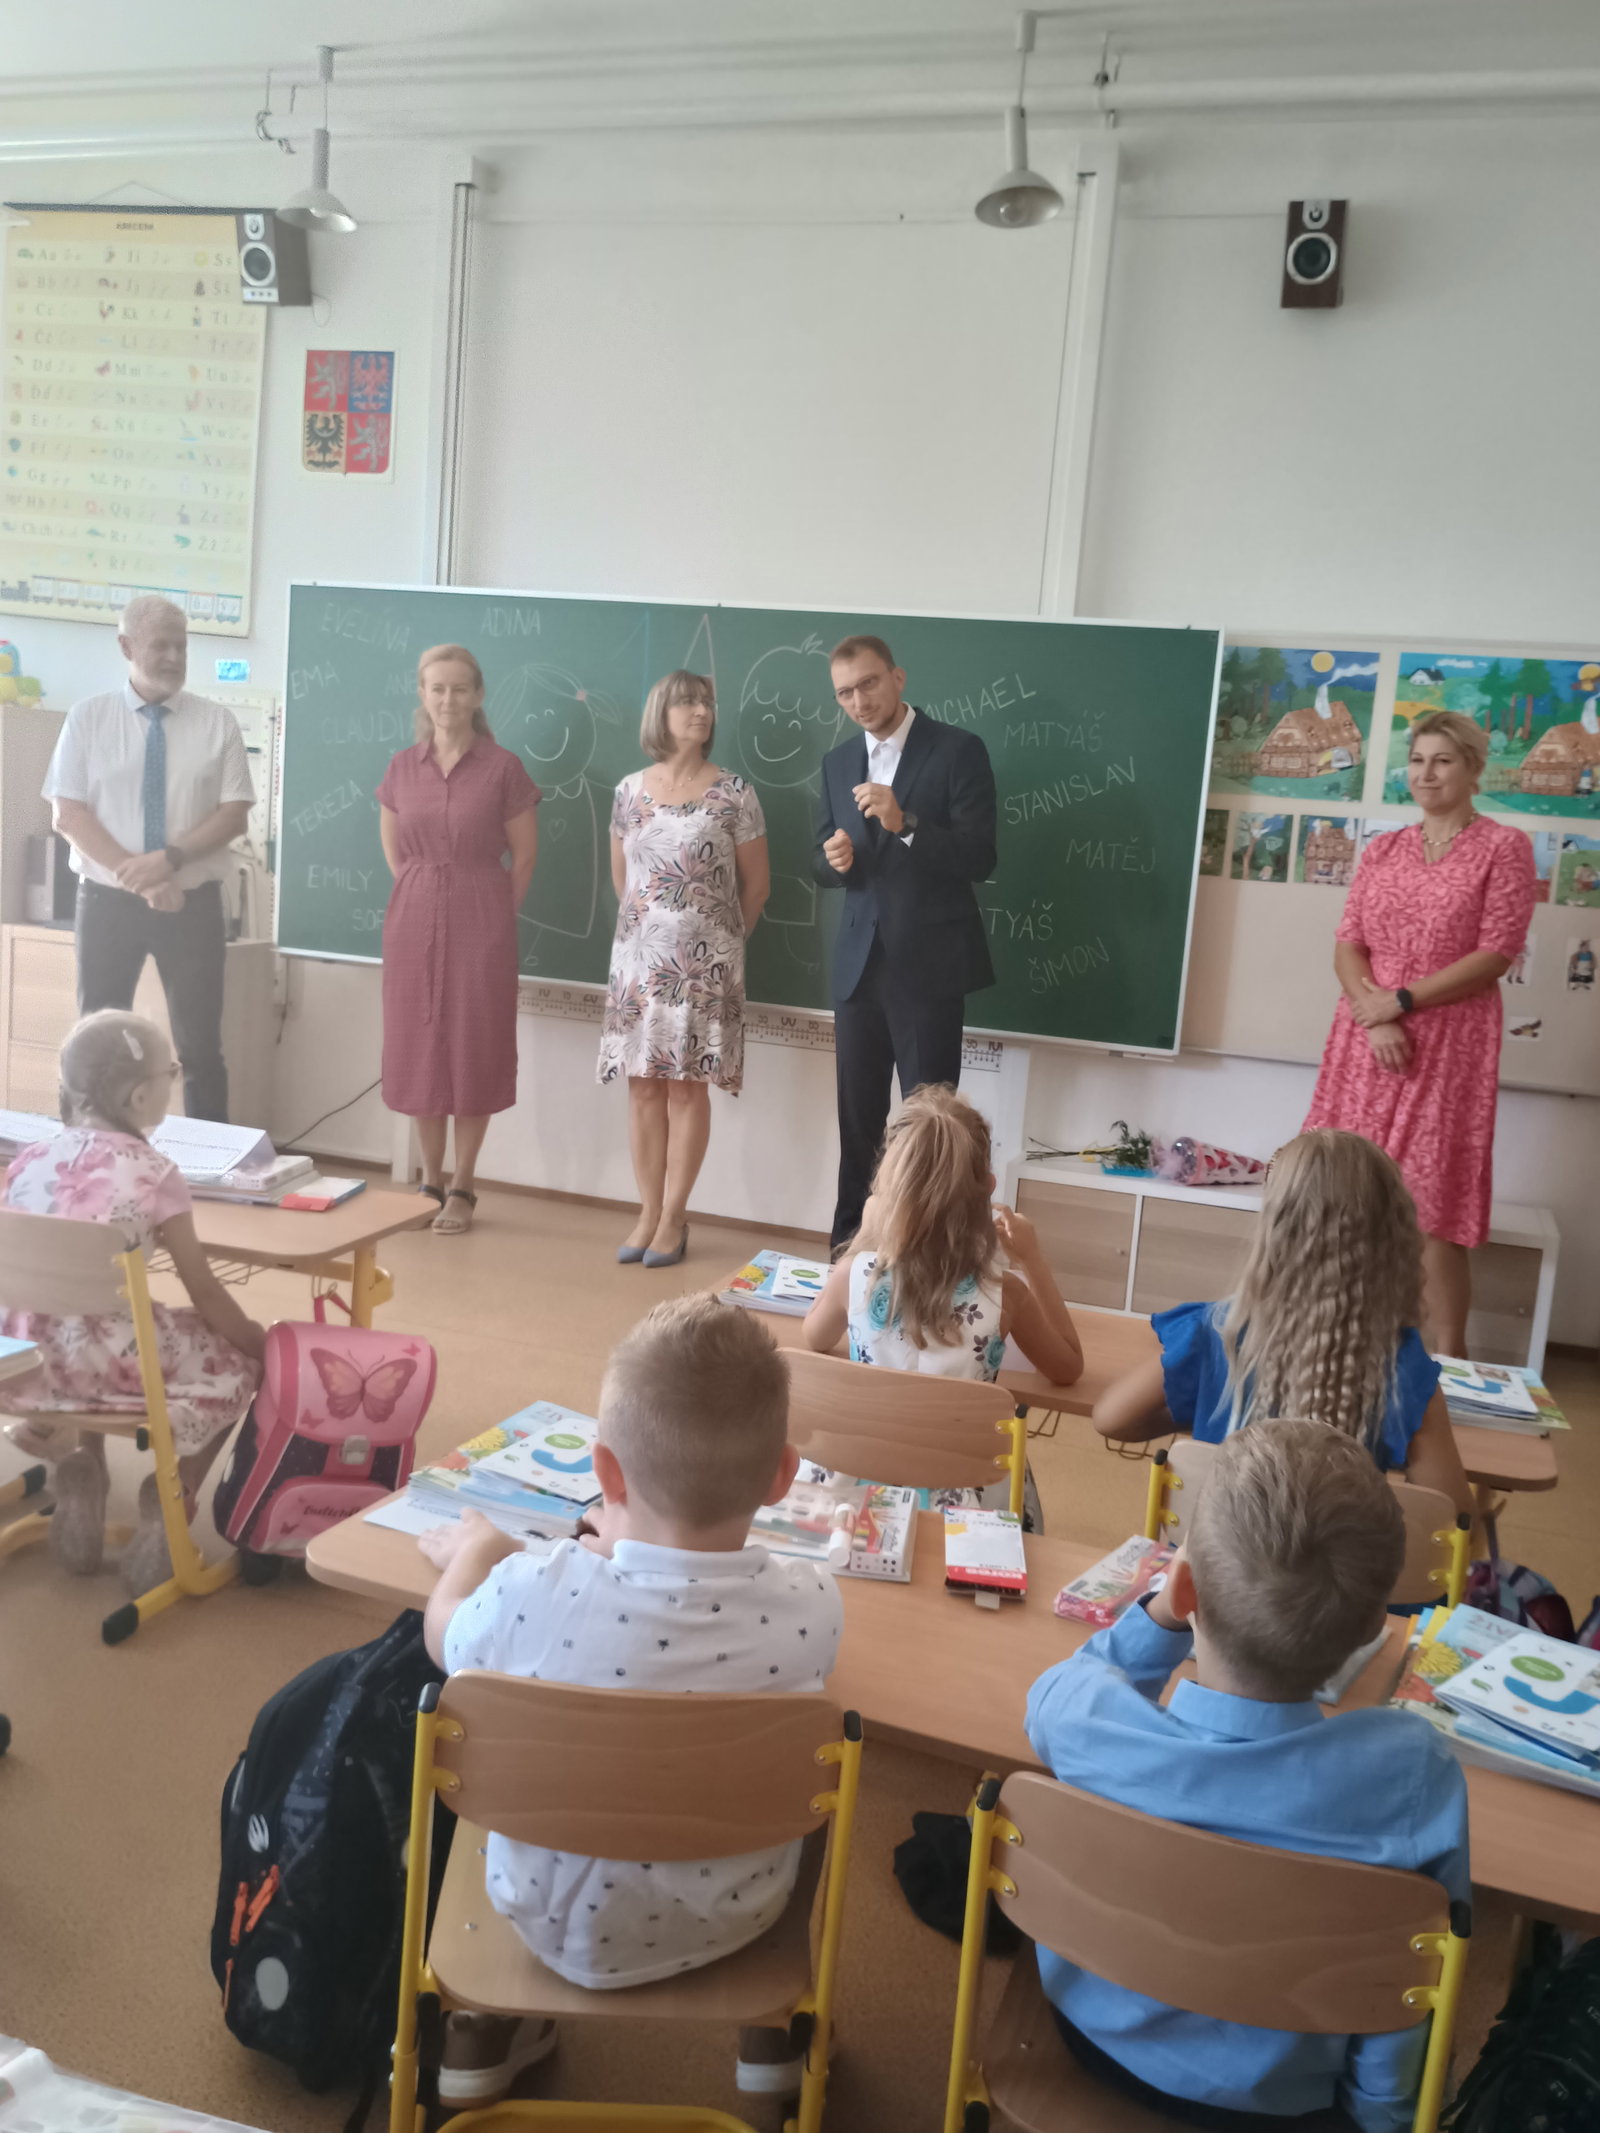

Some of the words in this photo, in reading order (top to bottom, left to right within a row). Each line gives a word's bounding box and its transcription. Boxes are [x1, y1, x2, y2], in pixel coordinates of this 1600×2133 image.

[480, 606, 542, 637] ADINA
[290, 661, 341, 701] EMA
[383, 671, 419, 698] ANE
[924, 672, 1037, 726] MICHAEL
[321, 709, 415, 746] CLAUDI
[1004, 709, 1107, 753] MATYÁŠ
[290, 778, 366, 838] TEREZA
[1004, 755, 1136, 825] STANISLAV
[1065, 836, 1157, 875] MATĚJ
[306, 864, 374, 893] EMILY
[352, 908, 386, 934] SOF
[977, 899, 1055, 942] TYÁŠ
[1027, 935, 1111, 995] ŠIMON
